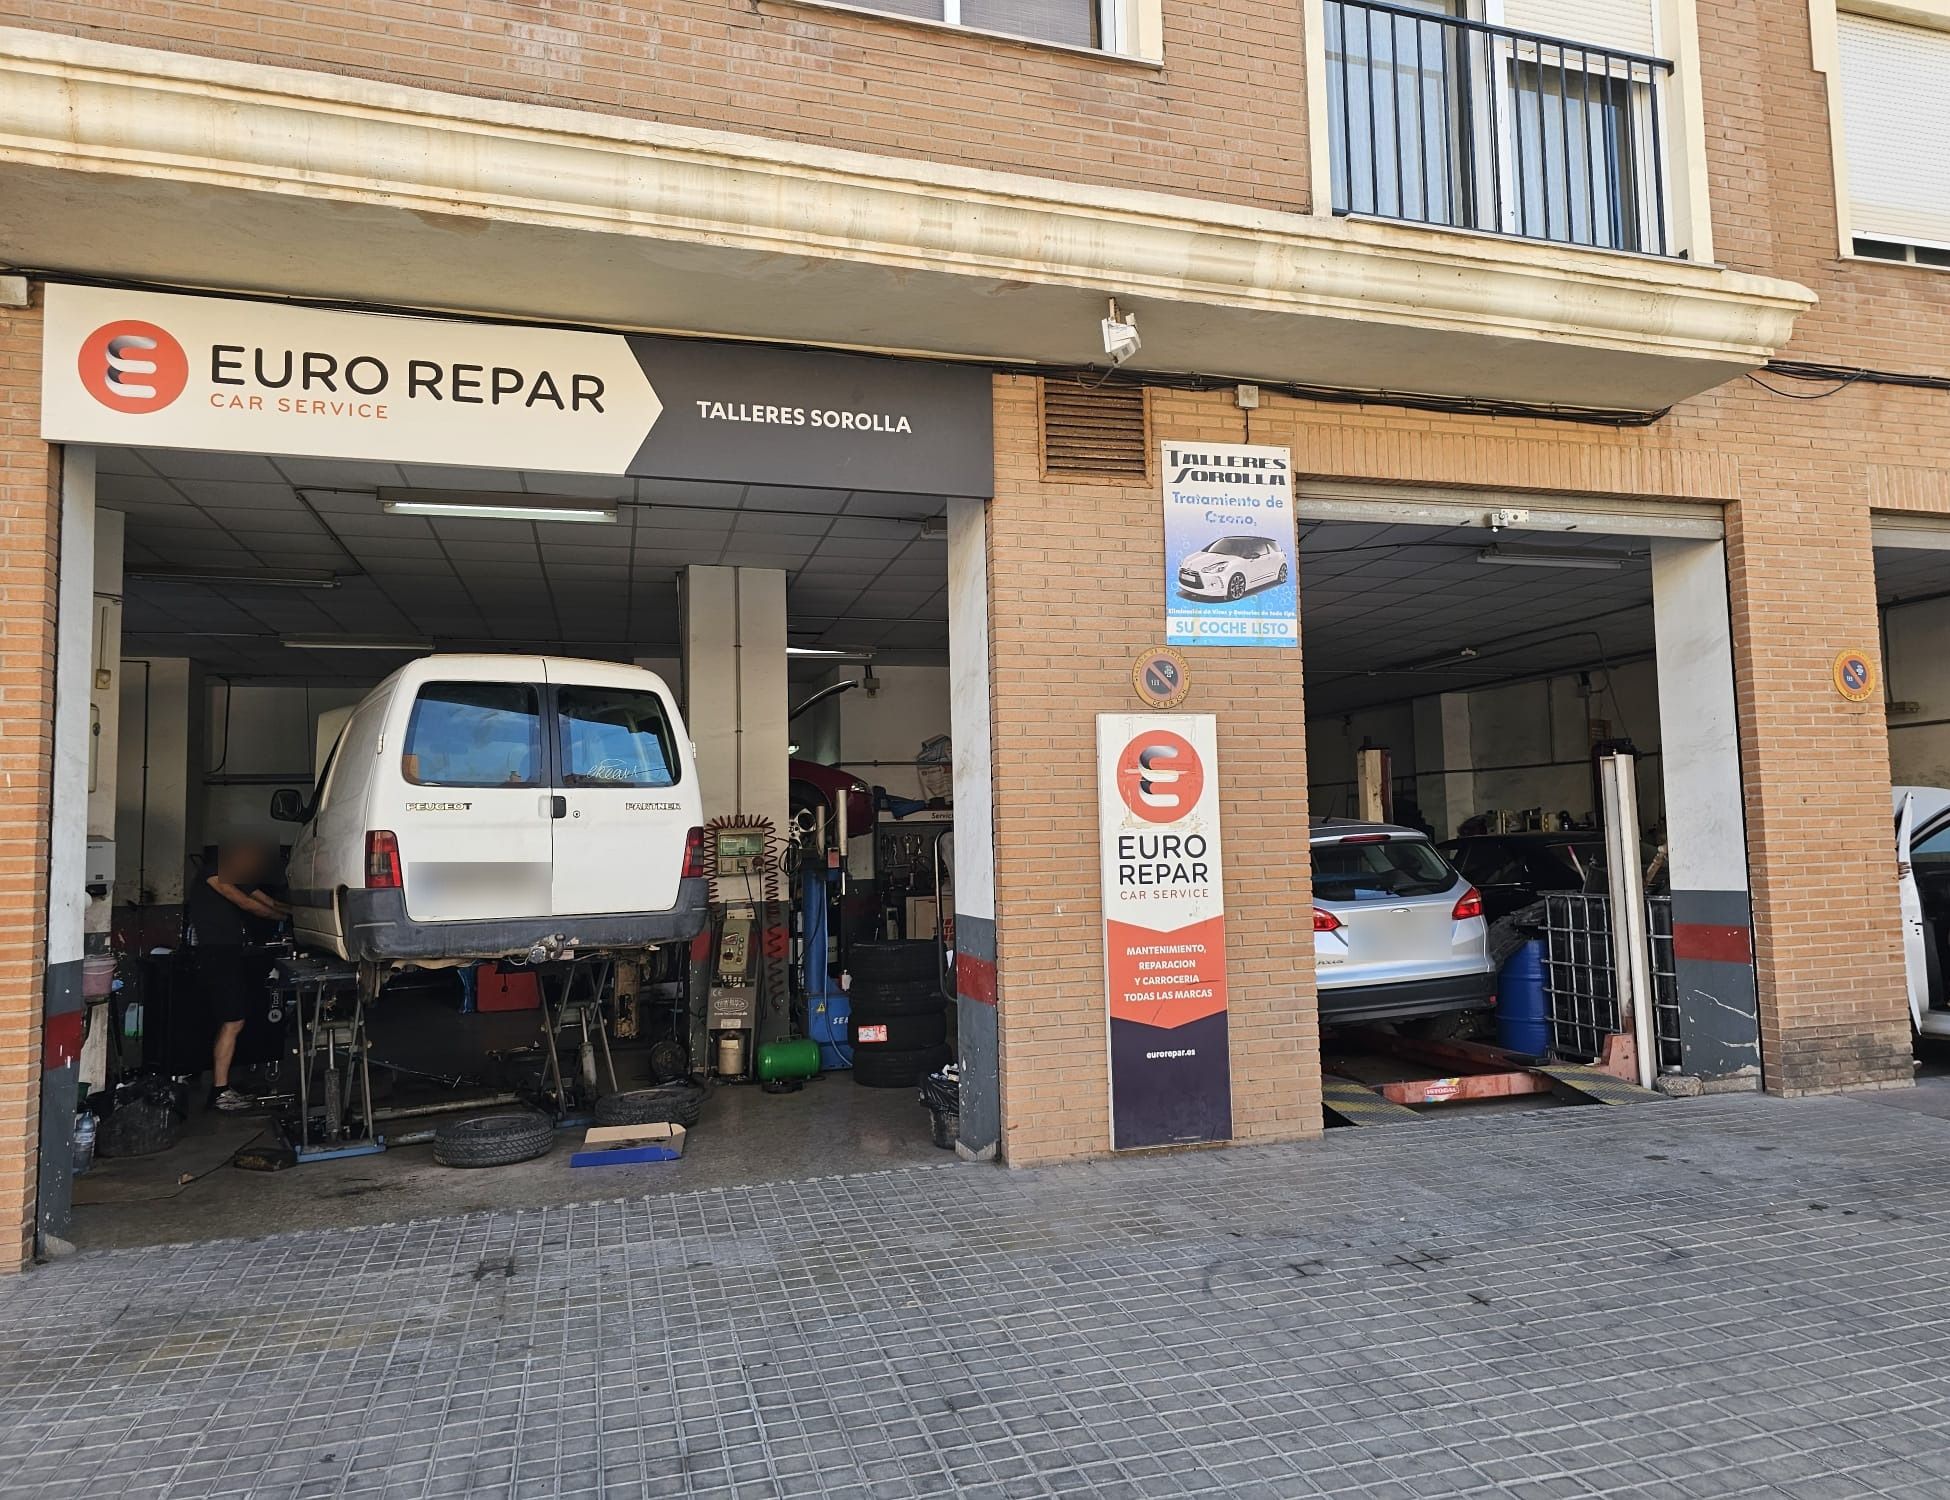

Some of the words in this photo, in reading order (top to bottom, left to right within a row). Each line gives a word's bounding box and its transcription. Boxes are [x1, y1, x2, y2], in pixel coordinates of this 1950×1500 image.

[211, 344, 389, 395] EURO
[408, 359, 605, 413] REPAR
[210, 393, 263, 411] CAR
[278, 398, 389, 419] SERVICE
[696, 400, 805, 426] TALLERES
[810, 409, 912, 434] SOROLLA
[1166, 449, 1287, 470] TALLERES
[1168, 467, 1286, 486] SOROLLA
[1172, 491, 1261, 508] Tratamiento
[1266, 495, 1284, 509] de
[1175, 620, 1195, 633] SU
[1199, 621, 1247, 634] COCHE
[1251, 622, 1289, 635] LISTO
[405, 802, 473, 811] PEUGEOT
[625, 802, 681, 811] PARTNER
[1118, 834, 1207, 860] EURO
[1119, 862, 1209, 886] REPAR
[1120, 890, 1147, 900] CAR
[1153, 888, 1209, 899] SERVICE
[1126, 944, 1207, 956] MANTENIMIENTO,
[1138, 959, 1196, 970] REPARACION
[1134, 977, 1140, 986] Y
[1142, 974, 1200, 985] CARROCERIA
[1124, 991, 1155, 1002] TODAS
[1156, 990, 1173, 1000] LAS
[1174, 989, 1213, 999] MARCAS
[1146, 1048, 1196, 1059] eurorepar.es
